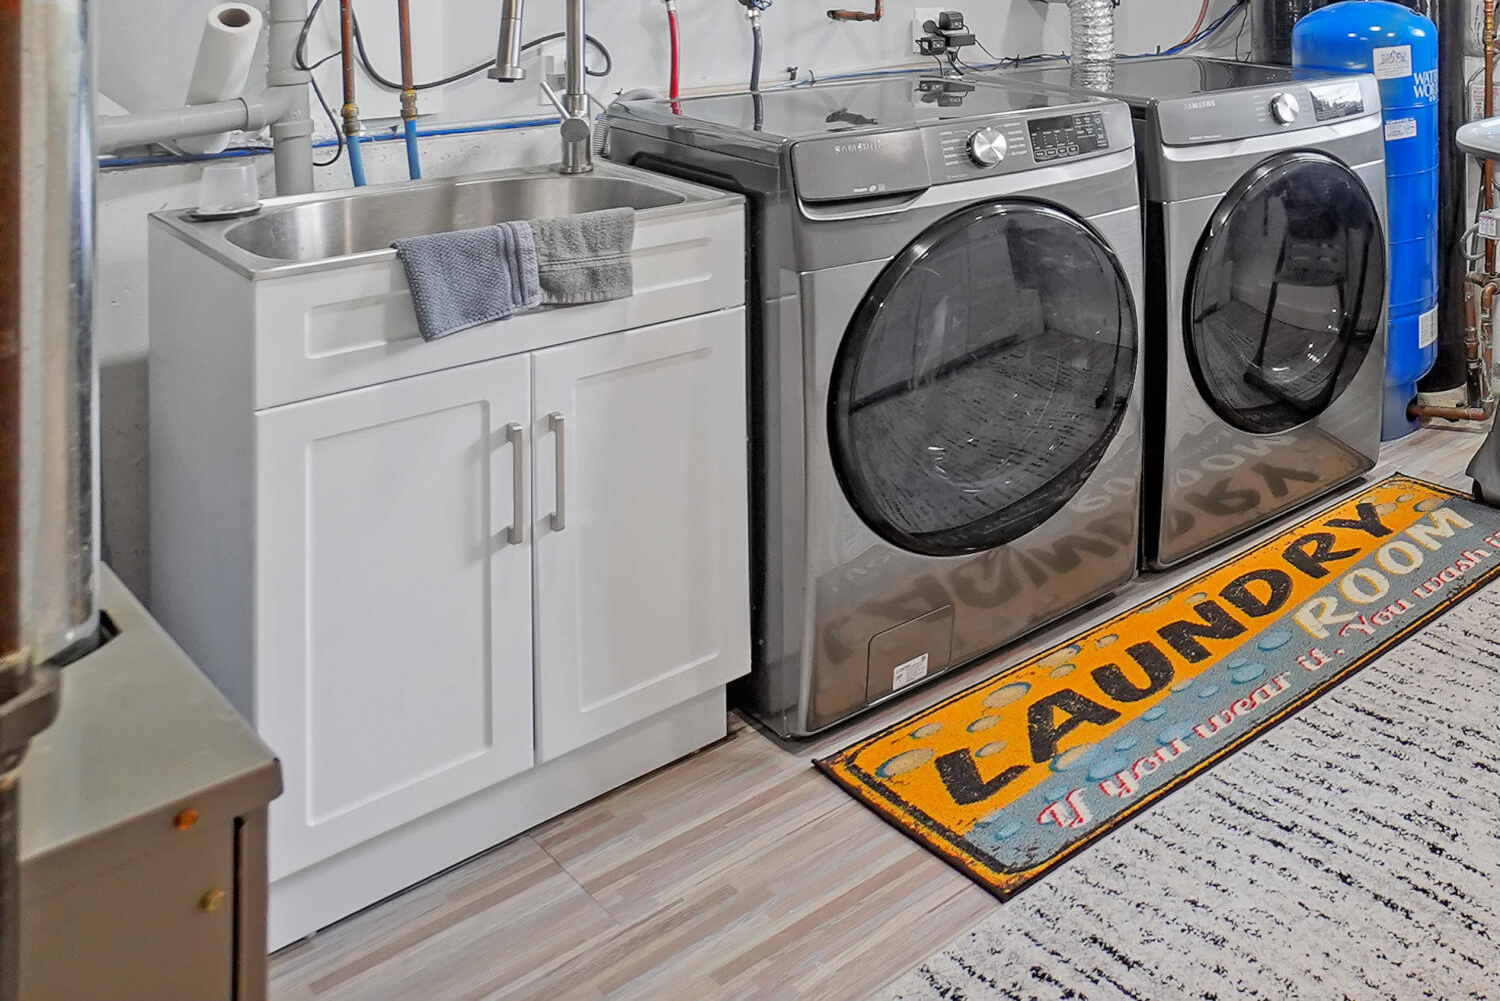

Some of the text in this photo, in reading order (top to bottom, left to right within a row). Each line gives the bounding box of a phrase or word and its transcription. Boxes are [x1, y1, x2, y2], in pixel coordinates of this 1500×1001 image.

[934, 503, 1393, 805] LAUNDRY
[1036, 787, 1093, 829] If
[1099, 737, 1192, 798] you
[1193, 671, 1293, 740] wear
[1338, 599, 1415, 637] You
[1411, 548, 1491, 599] wash
[1292, 507, 1474, 639] ROOM
